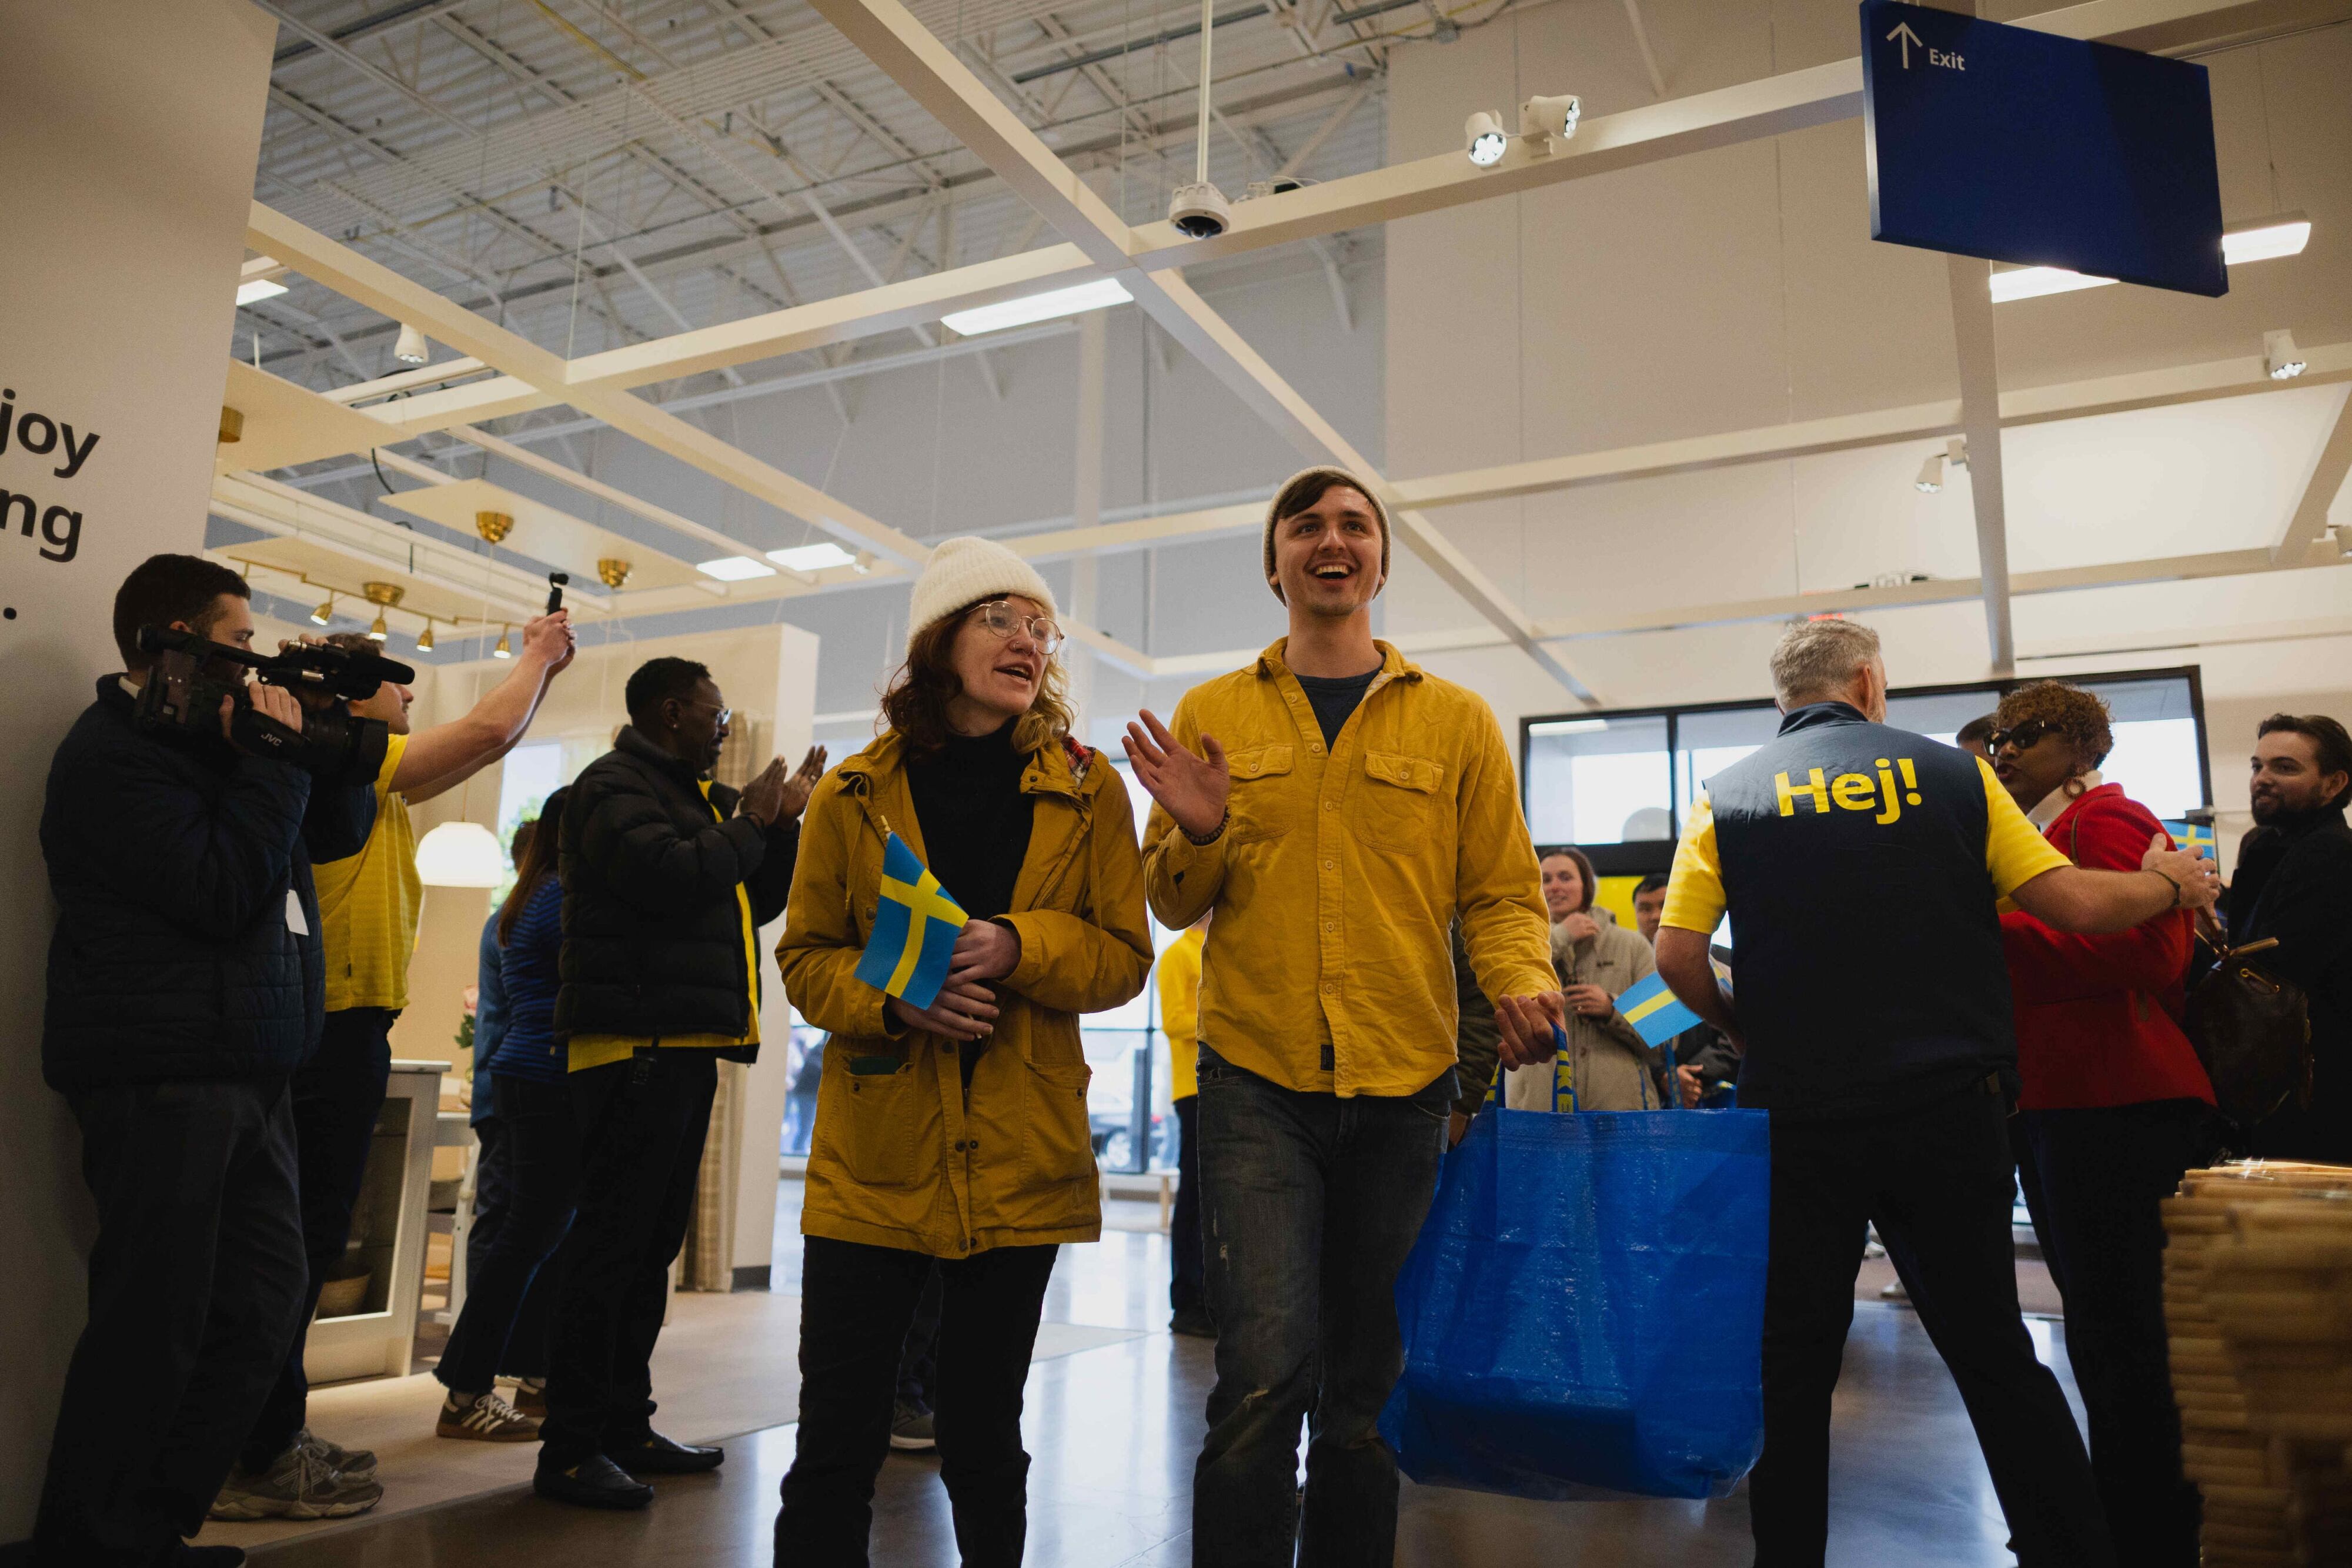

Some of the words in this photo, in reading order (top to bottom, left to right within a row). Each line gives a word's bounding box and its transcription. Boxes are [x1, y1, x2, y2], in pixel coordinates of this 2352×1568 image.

[1929, 48, 1966, 71] Exit
[0, 488, 83, 563] ng
[260, 733, 282, 747] JVC
[1775, 758, 1922, 824] Hej!
